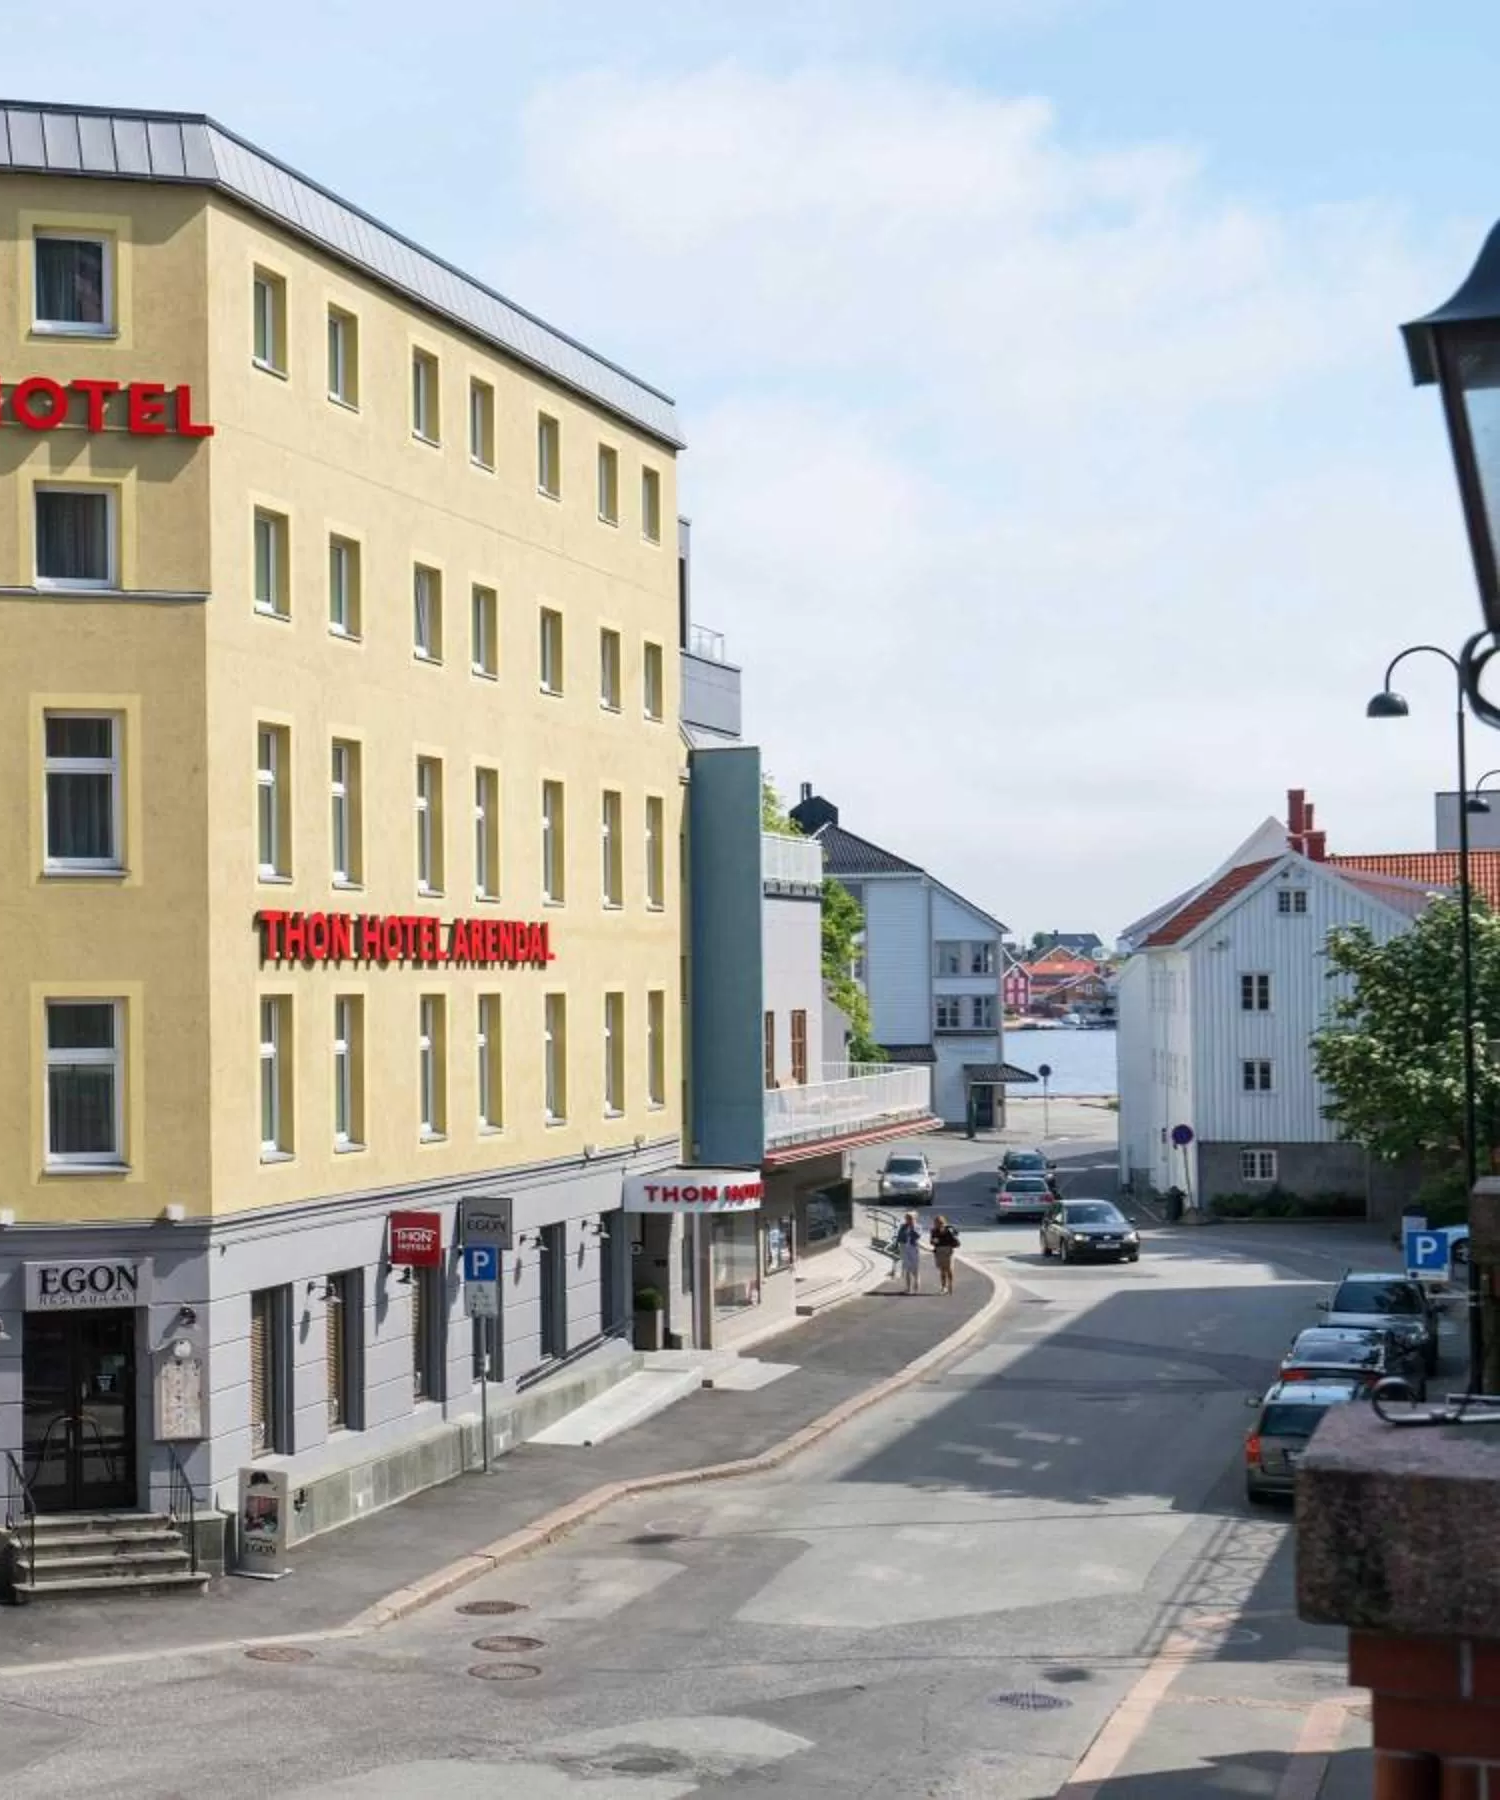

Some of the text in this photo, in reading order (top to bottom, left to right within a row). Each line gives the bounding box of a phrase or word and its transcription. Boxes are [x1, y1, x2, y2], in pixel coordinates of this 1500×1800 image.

[257, 910, 555, 962] THON HOTEL ARENDAL
[643, 1184, 718, 1203] THON
[395, 1230, 434, 1243] THON
[1416, 1235, 1438, 1265] P
[472, 1250, 490, 1277] P
[38, 1265, 139, 1295] EGON
[38, 1293, 137, 1305] RESTAURANT
